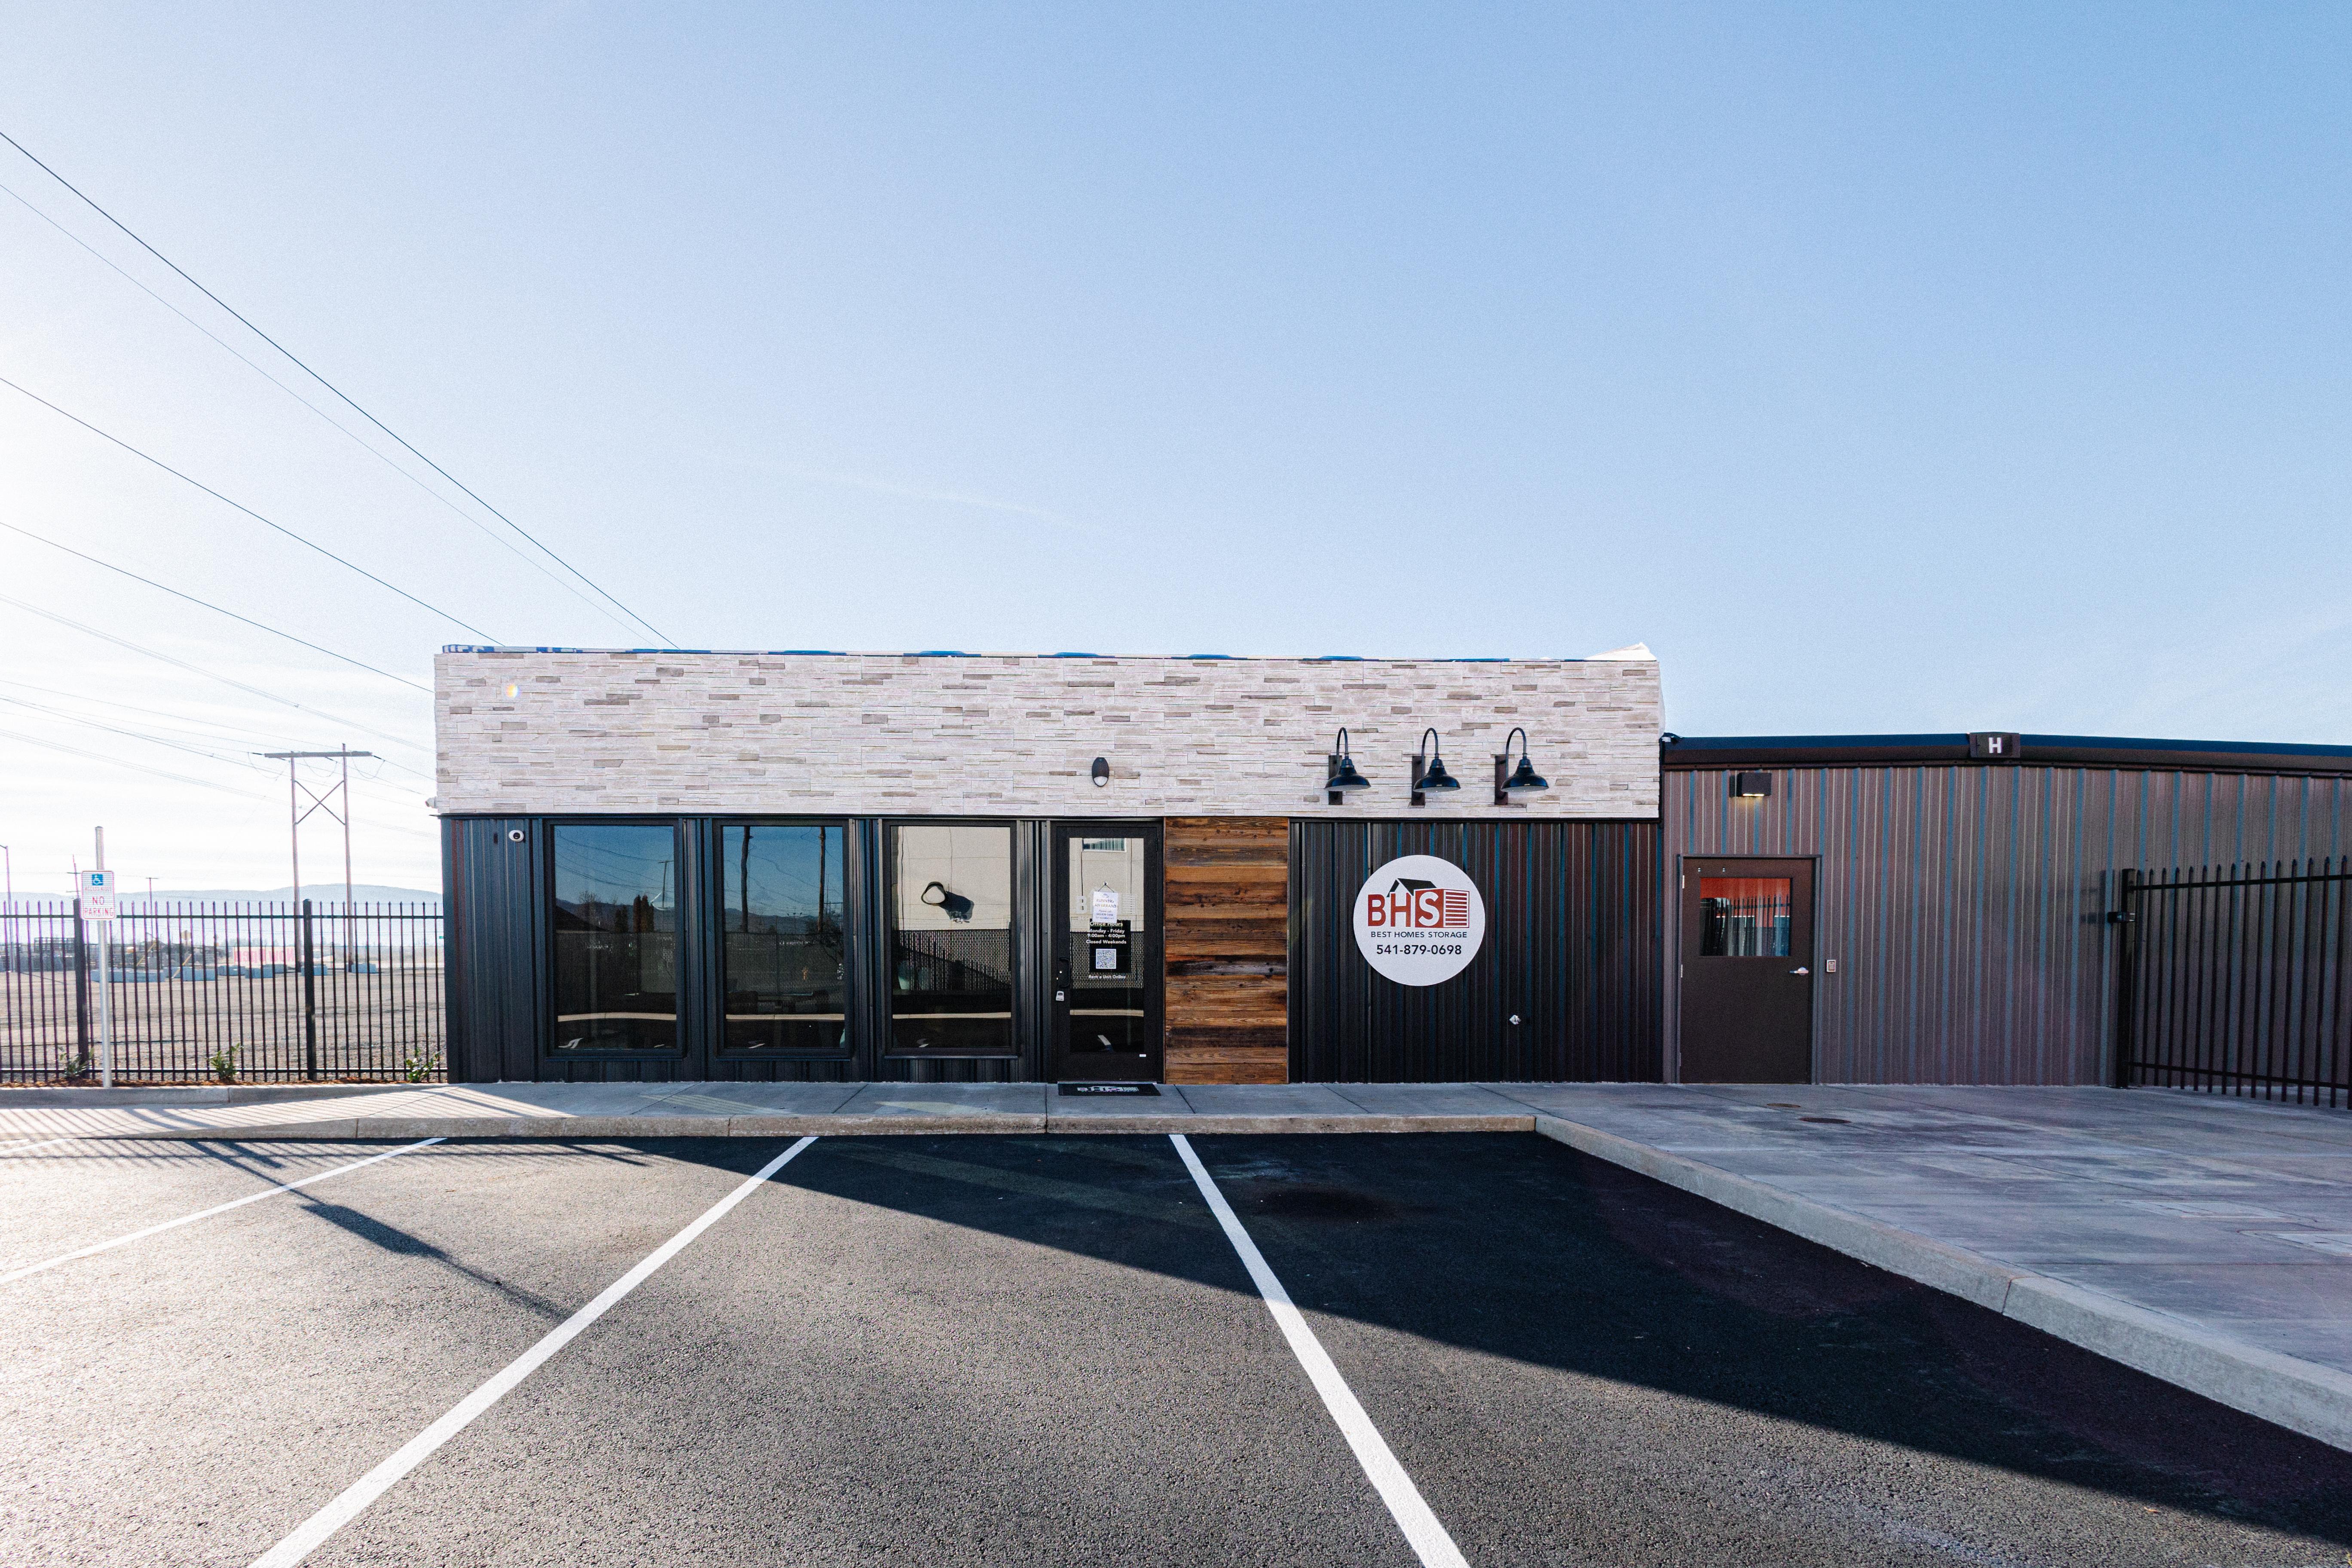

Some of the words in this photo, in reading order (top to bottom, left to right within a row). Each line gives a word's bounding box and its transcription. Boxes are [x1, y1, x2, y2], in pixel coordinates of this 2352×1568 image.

[1988, 737, 2002, 753] H
[92, 896, 104, 905] NO
[84, 907, 113, 916] PARKING
[1368, 891, 1440, 927] BHS
[1376, 944, 1462, 955] 541-879-0698
